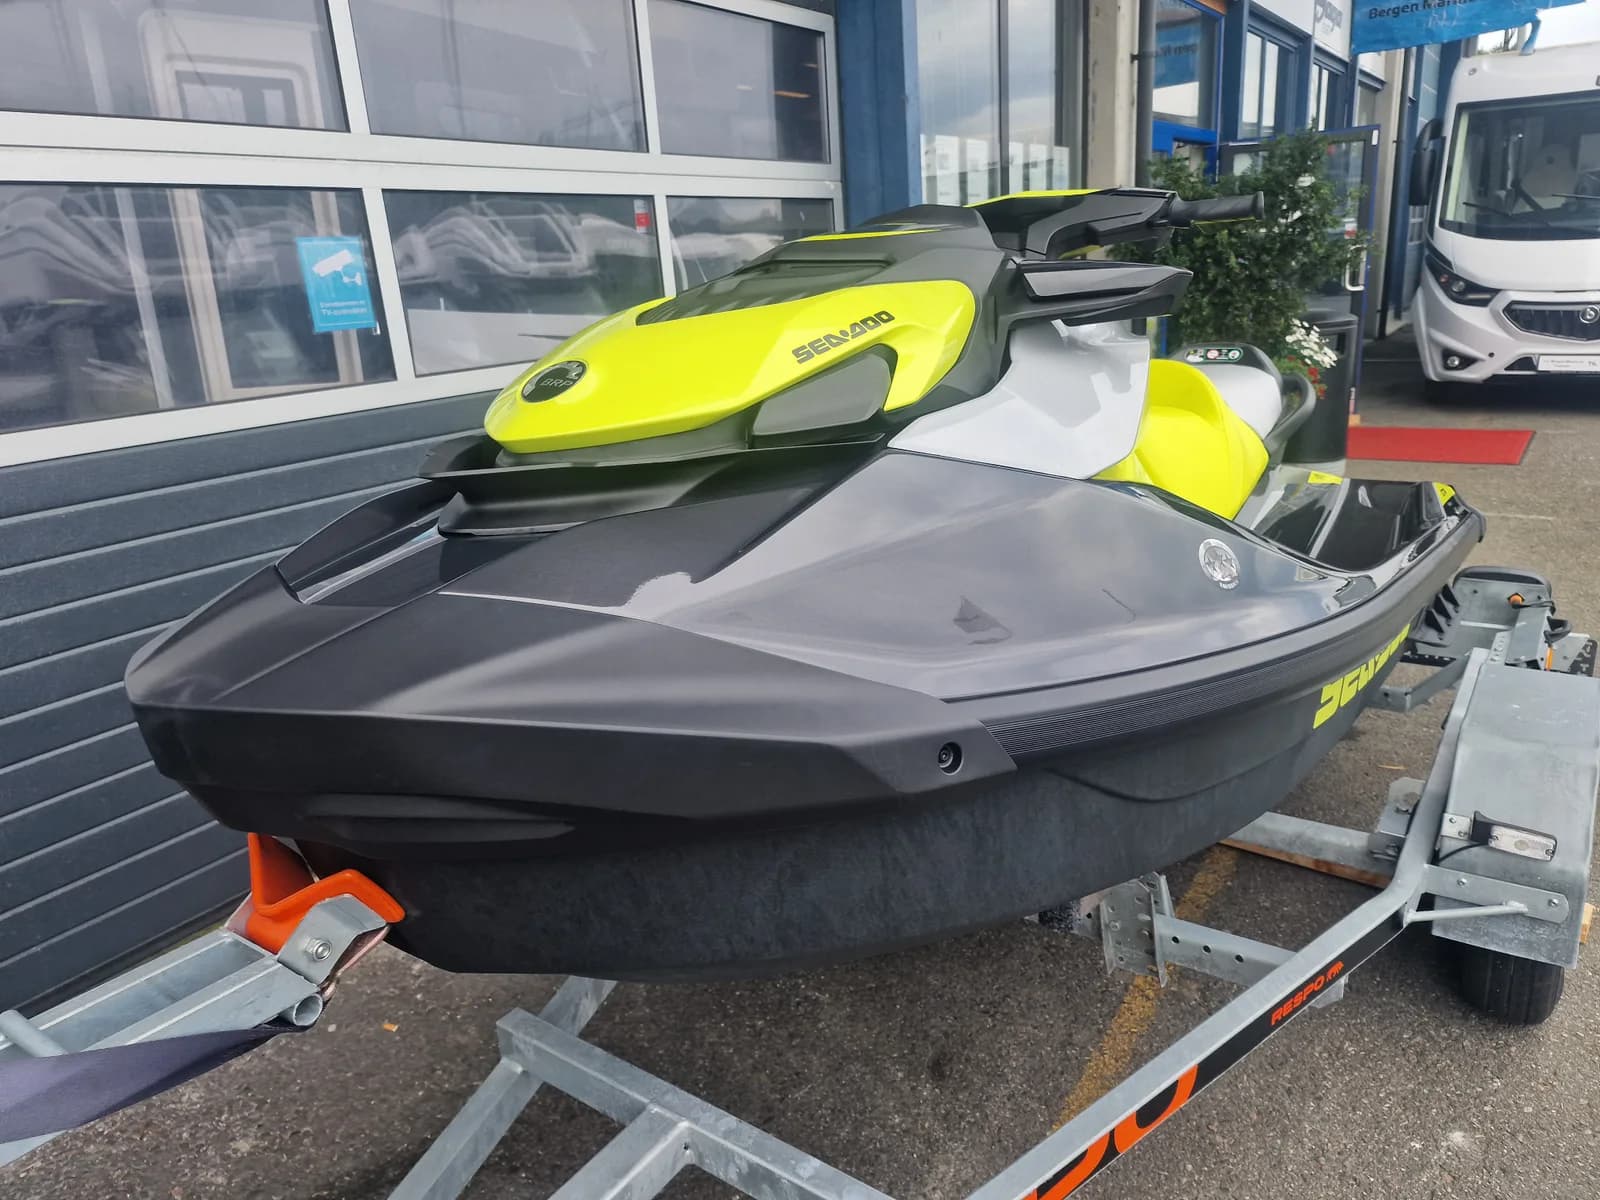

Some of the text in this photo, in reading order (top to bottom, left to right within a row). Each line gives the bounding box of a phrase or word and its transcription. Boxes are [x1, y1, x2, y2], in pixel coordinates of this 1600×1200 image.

[1368, 3, 1419, 19] Bergen
[540, 378, 574, 388] BRP
[1271, 974, 1326, 1026] RESPO
